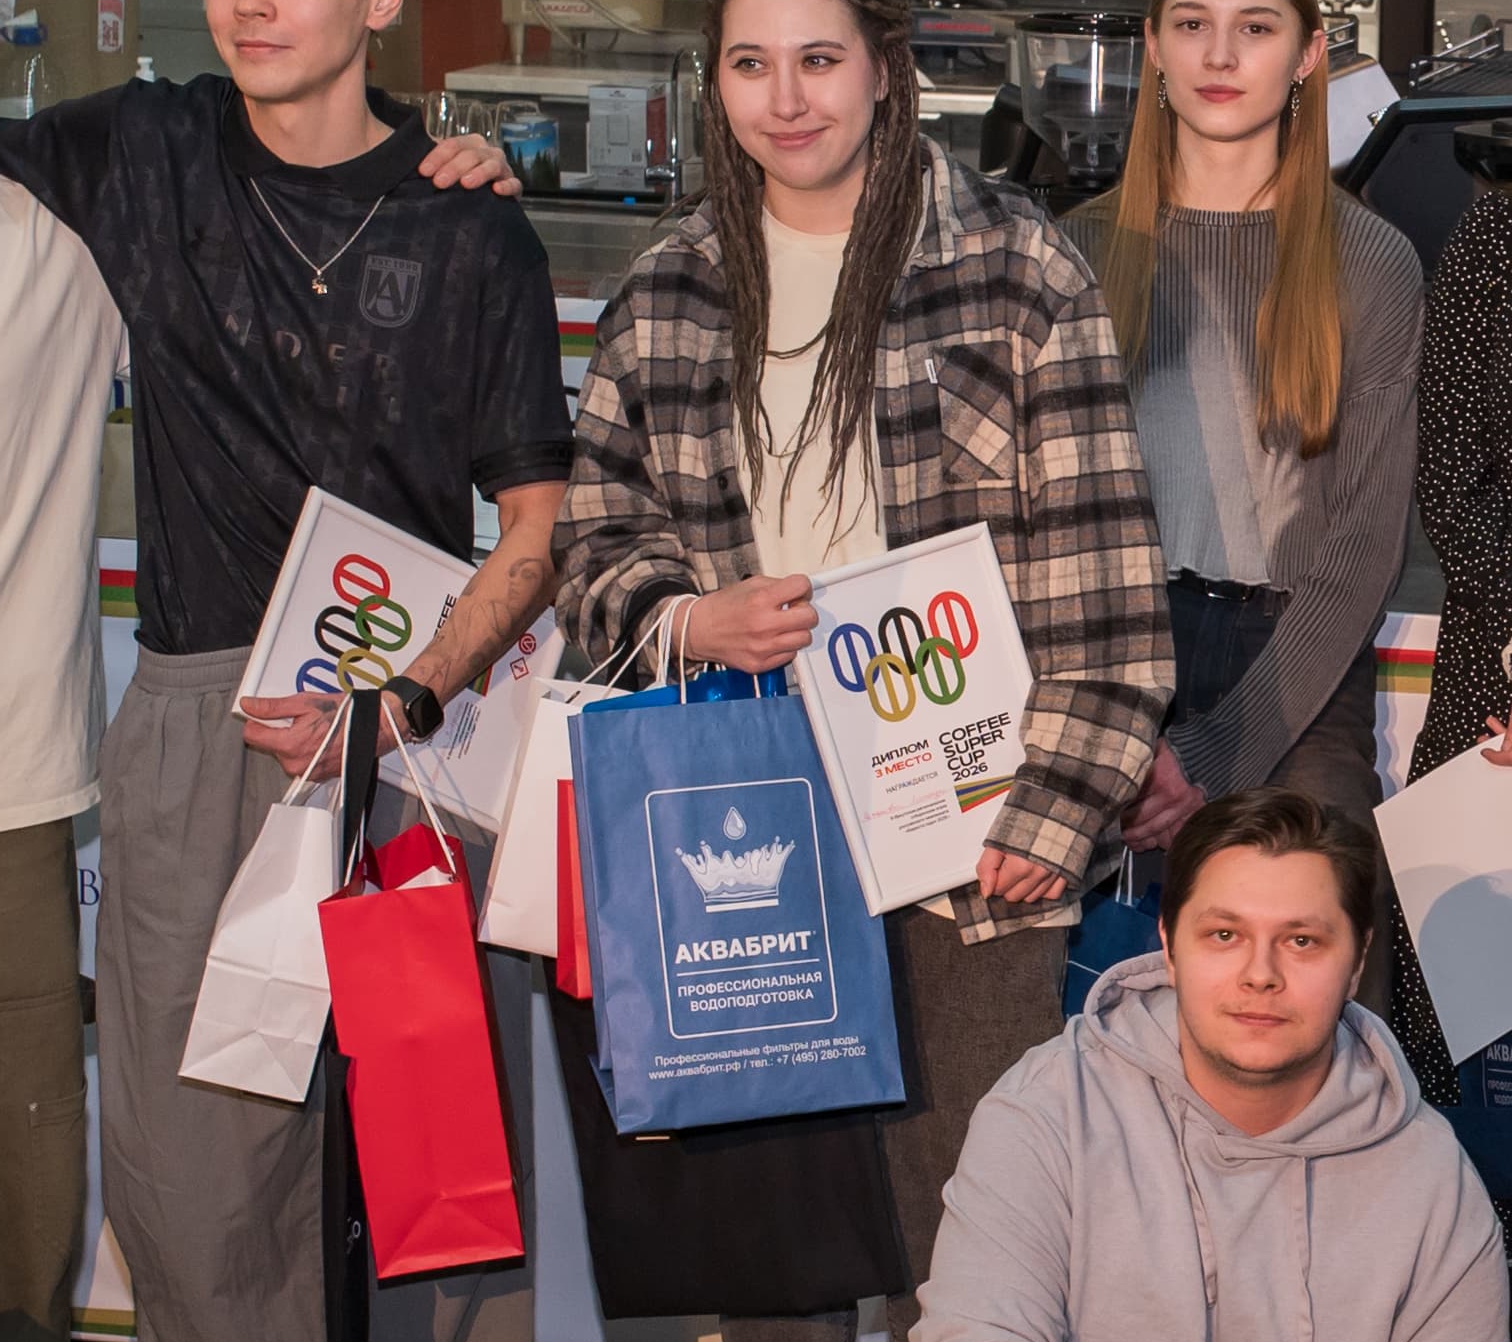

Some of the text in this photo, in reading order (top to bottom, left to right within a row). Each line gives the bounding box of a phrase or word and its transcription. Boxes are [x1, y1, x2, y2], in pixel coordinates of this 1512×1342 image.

[939, 711, 1012, 746] COFFEE
[871, 738, 930, 768] ДИПЛОМ
[943, 728, 1006, 759] SUPER
[874, 751, 933, 779] 3 МЕСТО
[947, 749, 986, 772] CUP
[952, 762, 989, 782] 2026
[674, 930, 811, 964] АКВАБРИТ
[677, 971, 823, 998] ПРОФЕССИОНАЛЬНАЯ
[689, 988, 814, 1012] ВОДОПОДГОТОВКА
[648, 1062, 741, 1081] www.аквабрит.рф
[777, 1054, 789, 1065] +7
[791, 1052, 819, 1067] (495)
[820, 1046, 867, 1061] 280-7002
[654, 1047, 760, 1067] Профессиональные
[762, 1041, 809, 1056] фильтры
